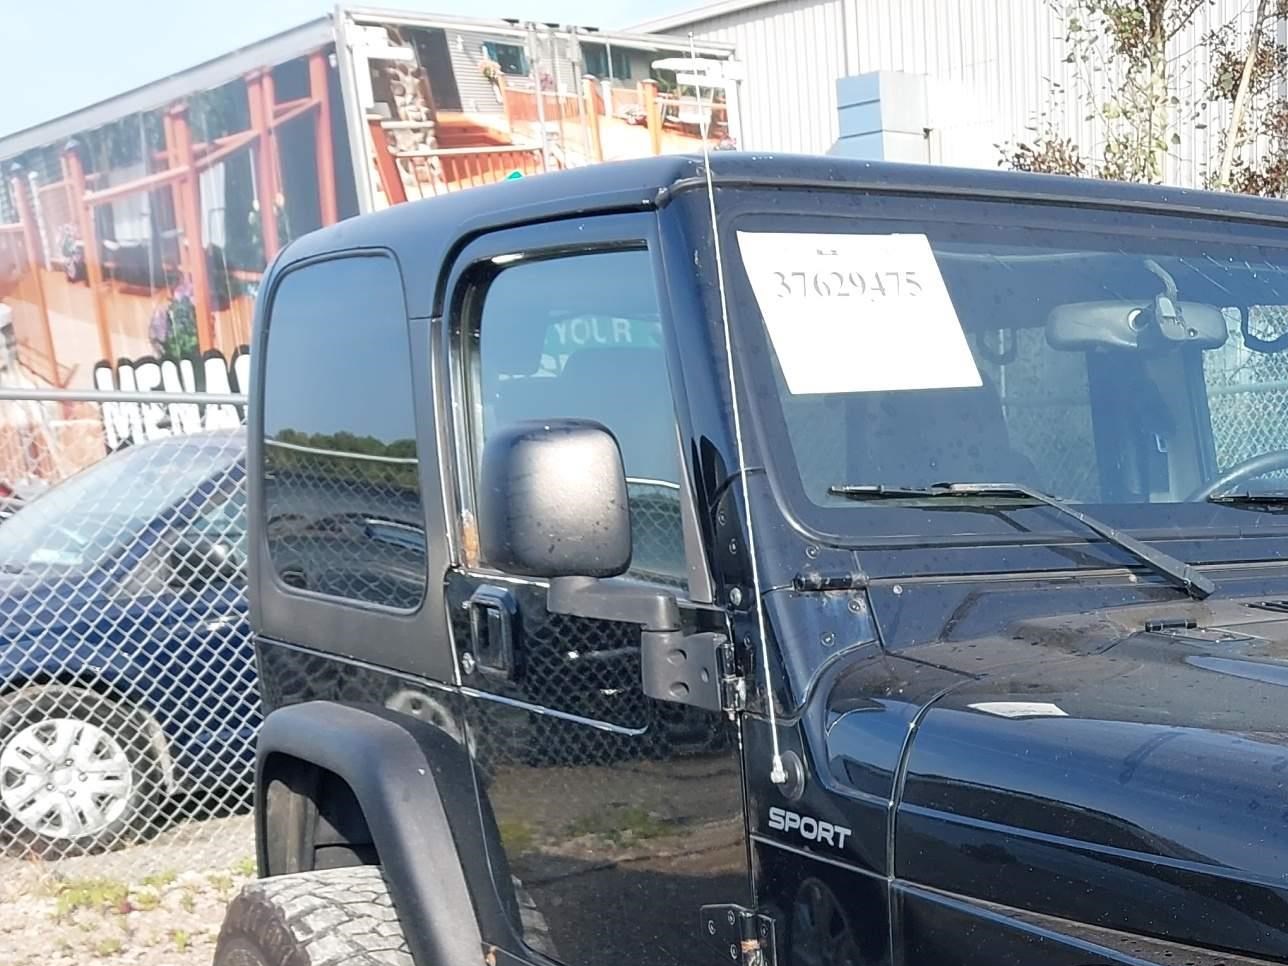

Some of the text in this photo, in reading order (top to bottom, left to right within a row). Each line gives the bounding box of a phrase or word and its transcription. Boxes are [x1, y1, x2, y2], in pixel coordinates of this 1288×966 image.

[773, 271, 923, 298] 37629475
[554, 316, 633, 345] YOUR
[768, 806, 852, 849] SPORT
